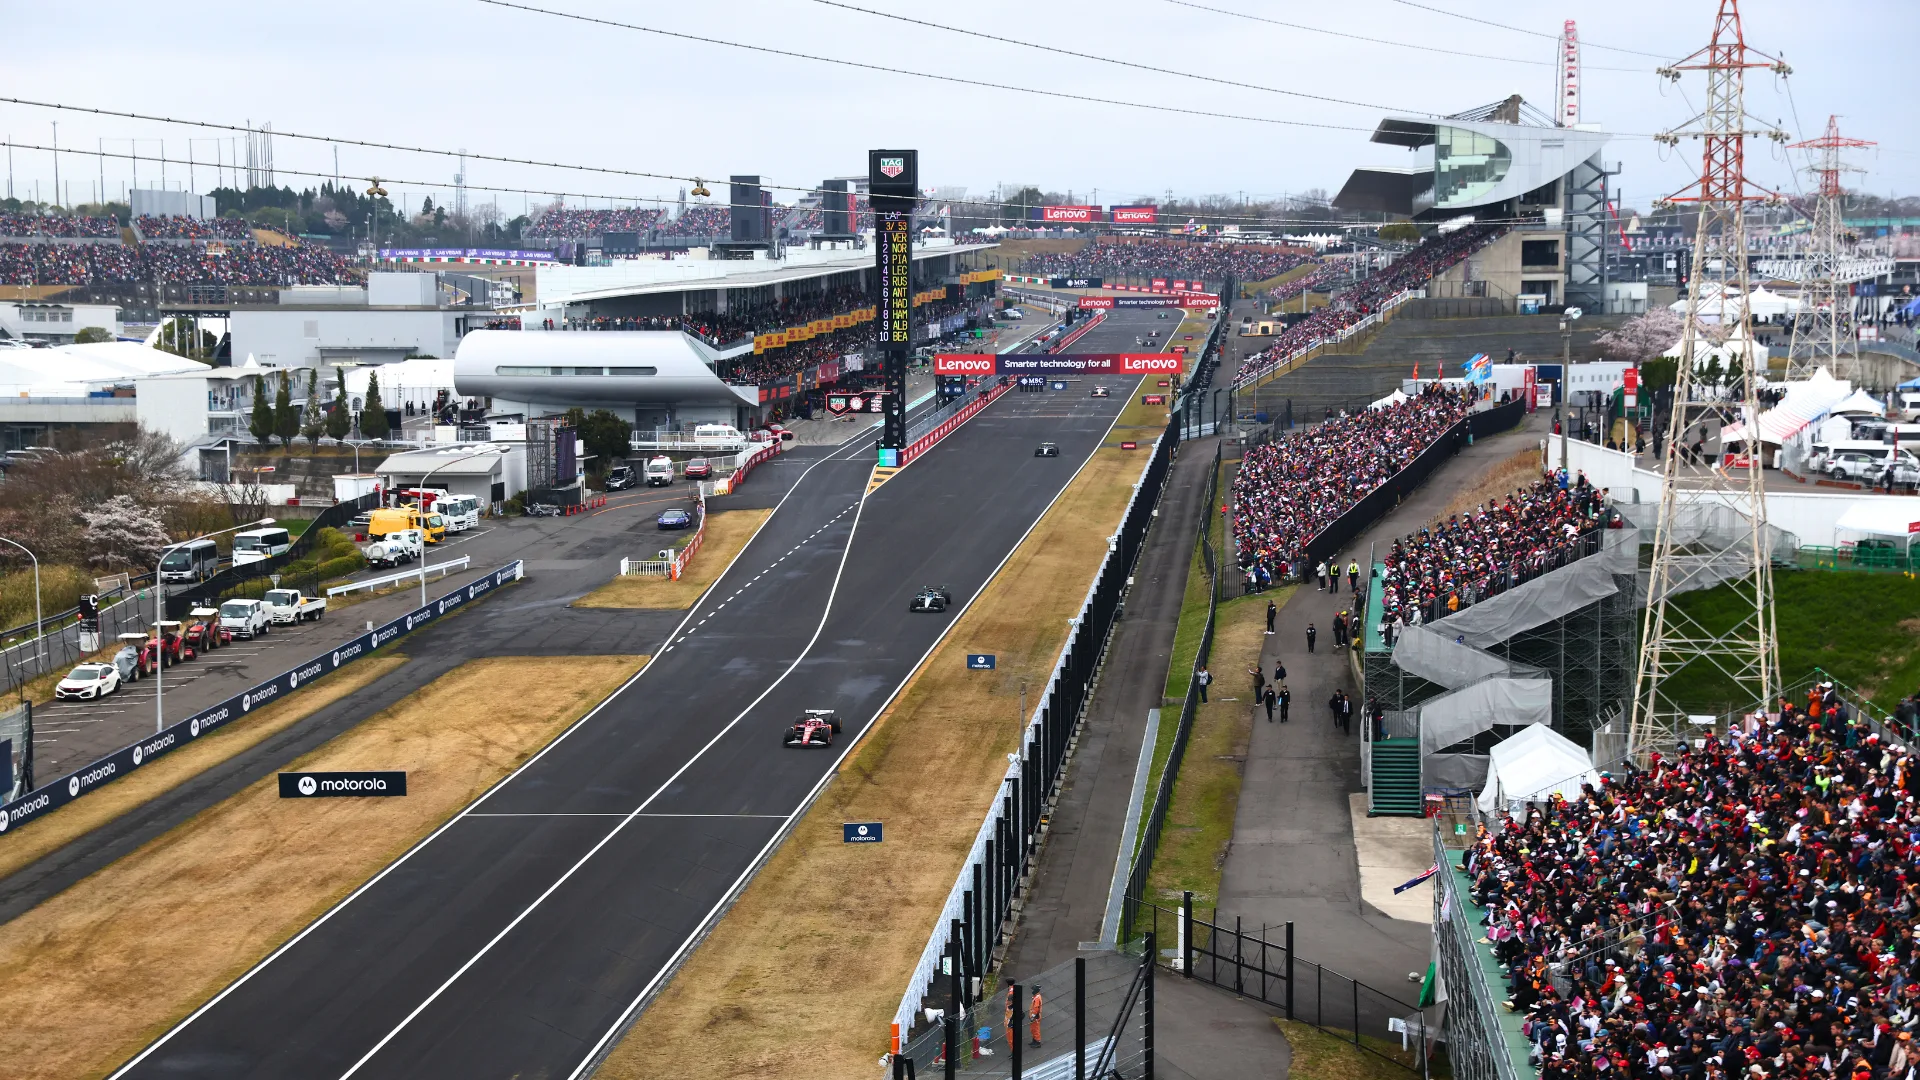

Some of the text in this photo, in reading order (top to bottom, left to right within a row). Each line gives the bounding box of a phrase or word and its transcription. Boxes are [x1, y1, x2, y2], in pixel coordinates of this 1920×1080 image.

[1047, 209, 1087, 219] Lenovo
[898, 222, 907, 230] 53
[883, 233, 907, 242] 1 VER
[883, 243, 907, 253] 2 NOR
[883, 254, 907, 264] 3 PIA
[883, 265, 907, 275] 4 LEC
[883, 276, 907, 286] 5 RUS
[883, 288, 907, 297] 6 ANT
[883, 299, 907, 308] 7 HAD
[883, 310, 907, 319] 8 HAM
[884, 321, 907, 330] 9 ALB
[880, 332, 907, 341] 10 BEA
[939, 358, 990, 370] Lenovo
[1040, 360, 1086, 369] technology
[1088, 359, 1099, 367] for
[1101, 359, 1111, 367] all
[1125, 358, 1177, 369] Lenovo
[413, 610, 431, 624] motorola
[378, 626, 397, 642] motorola
[340, 643, 362, 660] motorola
[298, 663, 322, 681] motorola
[251, 684, 278, 704] motorola
[200, 708, 228, 729] motorola
[143, 733, 174, 756] motorola
[80, 762, 116, 788] motorola
[321, 778, 386, 790] motorola
[10, 794, 49, 822] motorola
